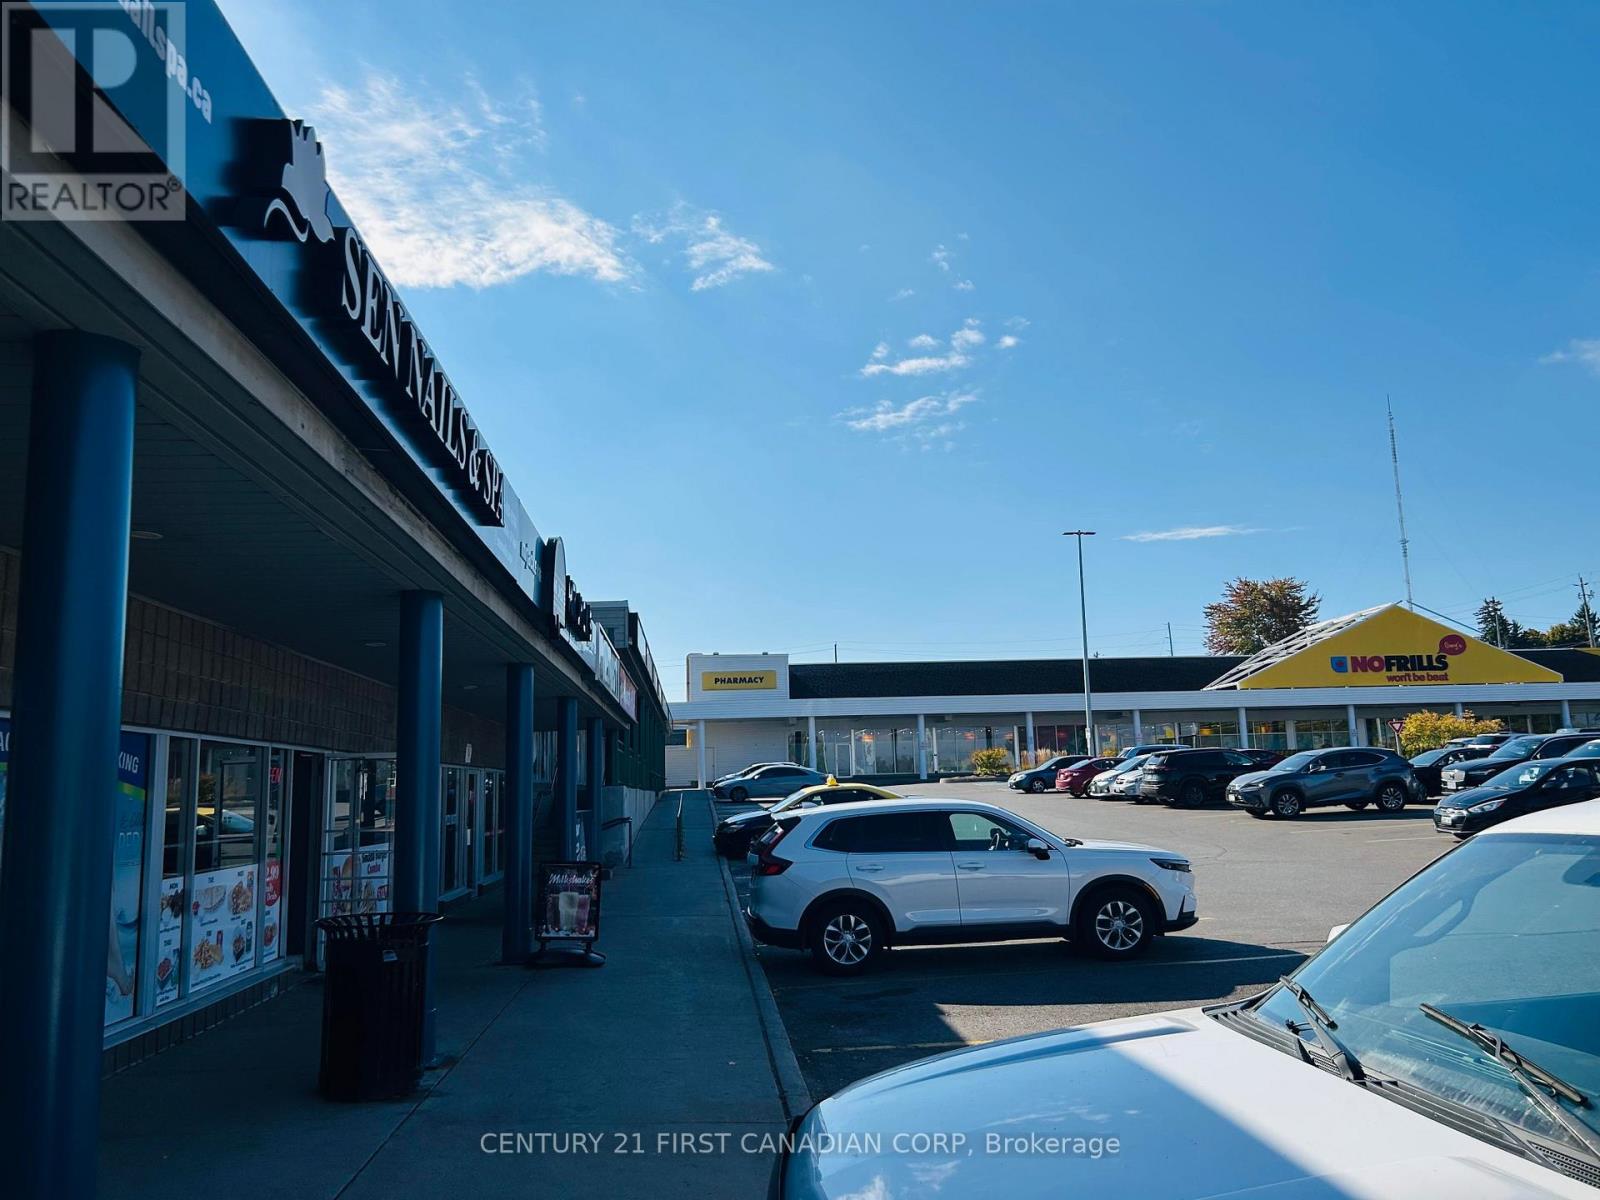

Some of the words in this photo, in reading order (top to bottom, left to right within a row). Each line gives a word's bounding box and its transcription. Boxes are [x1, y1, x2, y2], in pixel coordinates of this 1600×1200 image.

[342, 227, 404, 380] SEN
[406, 324, 468, 470] NAILS
[469, 429, 481, 491] &
[483, 449, 504, 527] SPA
[714, 676, 764, 684] PHARMACY
[1387, 673, 1412, 681] won't
[1413, 672, 1426, 682] be
[1427, 671, 1449, 682] beat
